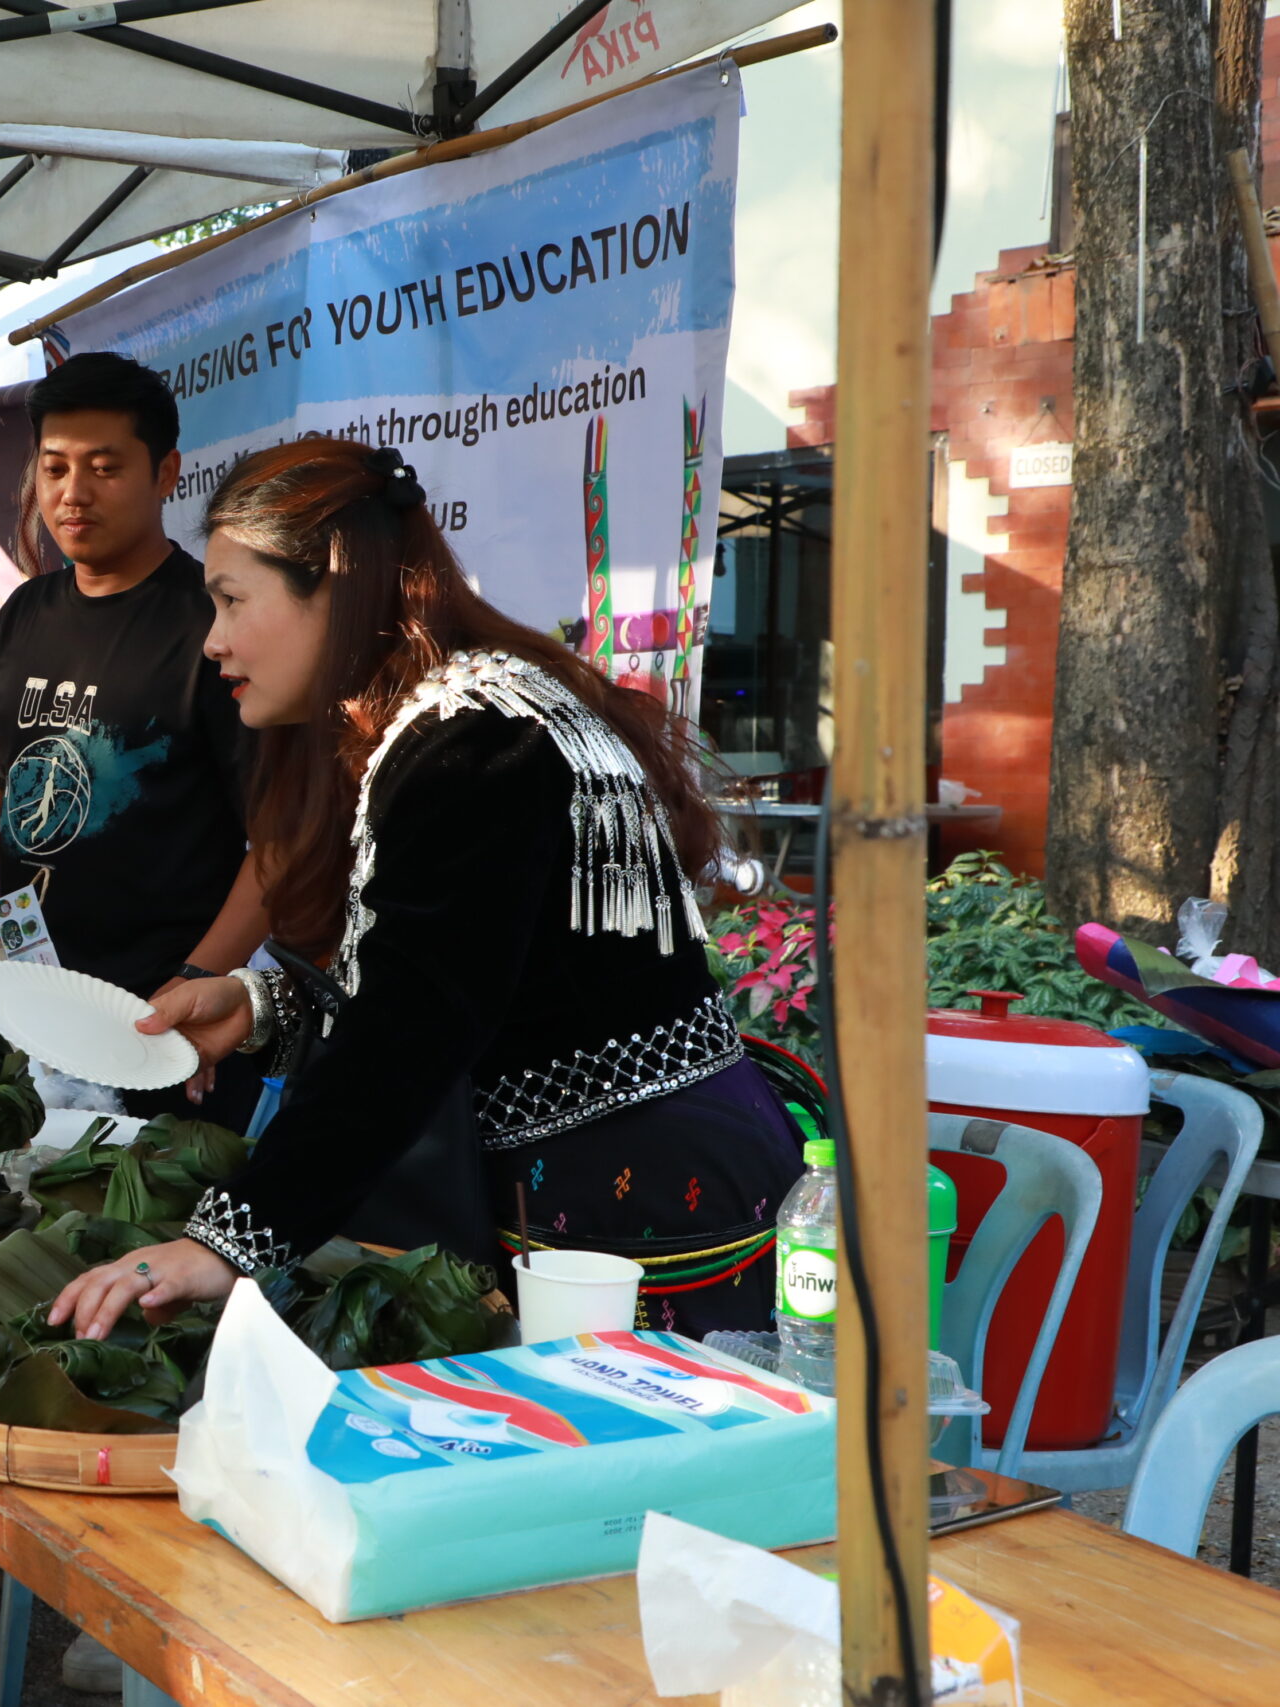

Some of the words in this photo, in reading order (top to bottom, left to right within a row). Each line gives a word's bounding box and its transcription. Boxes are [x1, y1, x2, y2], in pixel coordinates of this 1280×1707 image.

[327, 274, 447, 345] YOUTH
[456, 201, 690, 317] EDUCATION
[376, 393, 498, 447] through
[506, 364, 646, 428] education
[1016, 455, 1070, 475] CLOSED
[426, 501, 467, 531] UB
[788, 1261, 837, 1294] น้ำทิพ
[631, 1378, 705, 1411] TOWEL
